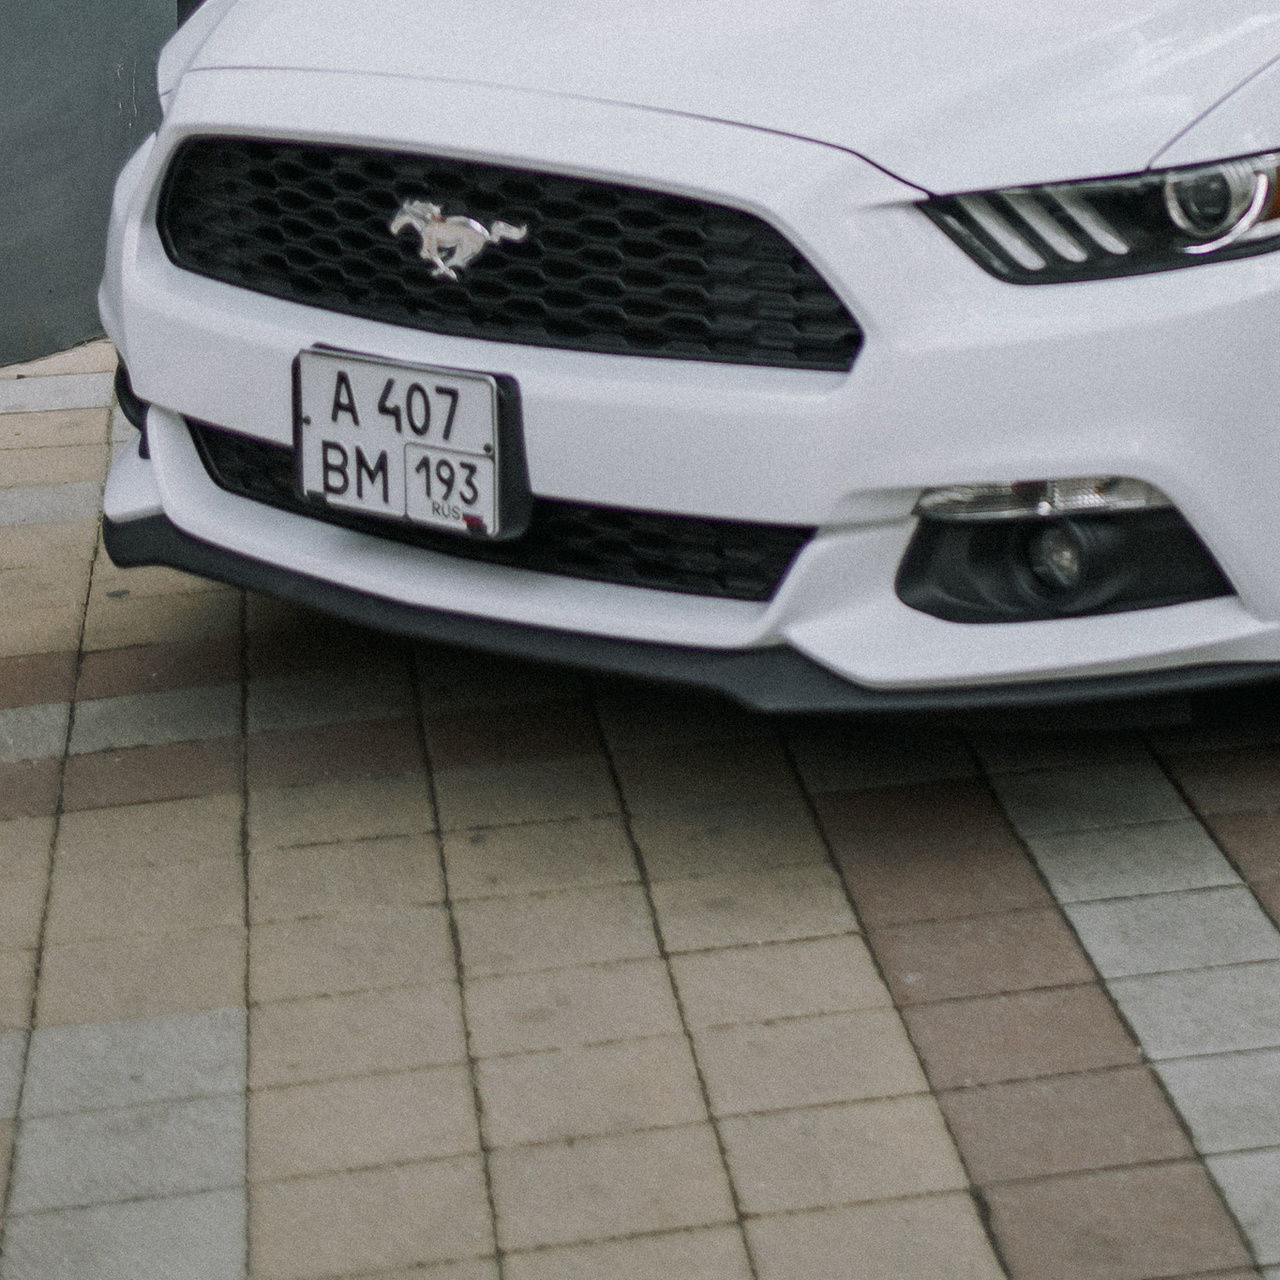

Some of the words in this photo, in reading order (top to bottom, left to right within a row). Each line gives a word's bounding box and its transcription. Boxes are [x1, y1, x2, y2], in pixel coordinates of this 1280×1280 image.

[377, 377, 460, 441] 407
[414, 455, 480, 506] 193
[431, 500, 461, 521] RUS
